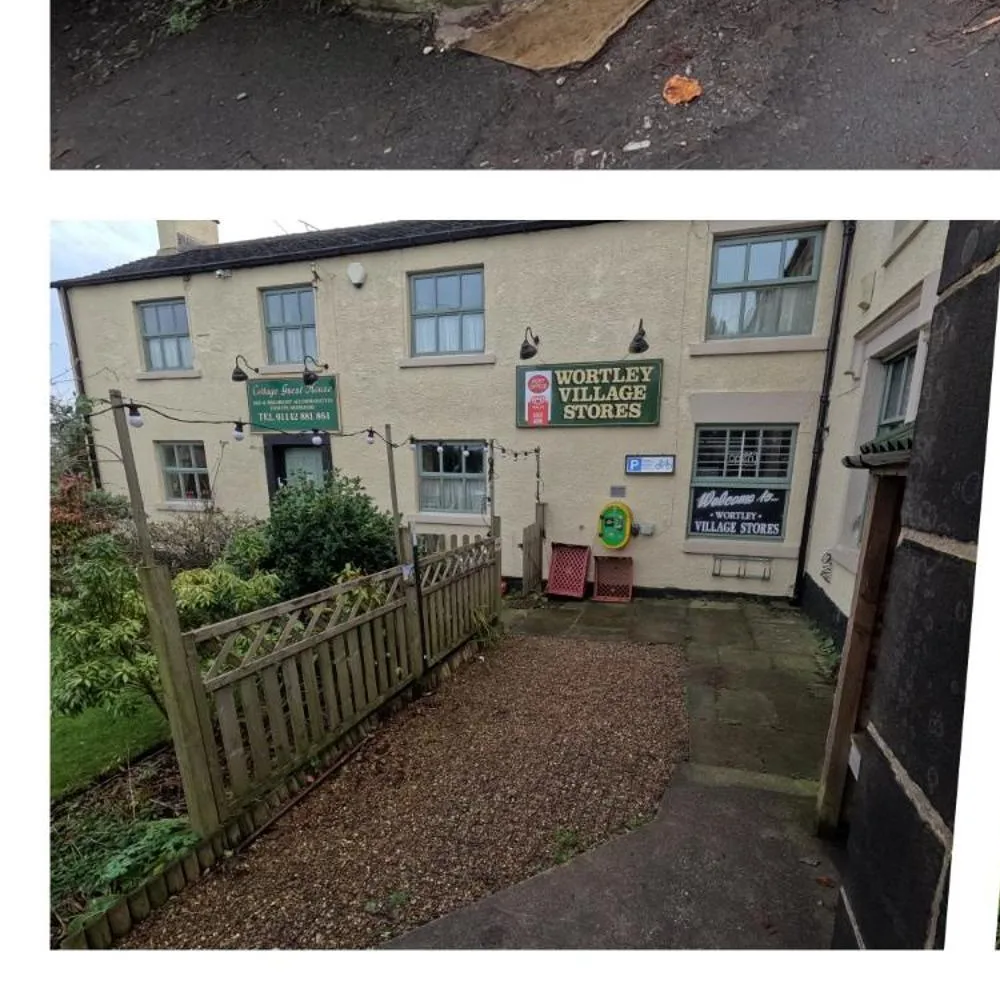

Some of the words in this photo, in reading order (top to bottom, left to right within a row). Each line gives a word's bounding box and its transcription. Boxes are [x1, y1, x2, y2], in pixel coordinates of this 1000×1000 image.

[554, 366, 654, 385] WORTLEY
[558, 385, 647, 402] VILLAGE
[563, 403, 641, 419] STORES
[630, 459, 640, 470] P
[696, 490, 755, 508] Welcome
[695, 520, 738, 533] VILLAGE
[740, 522, 779, 535] STORES
